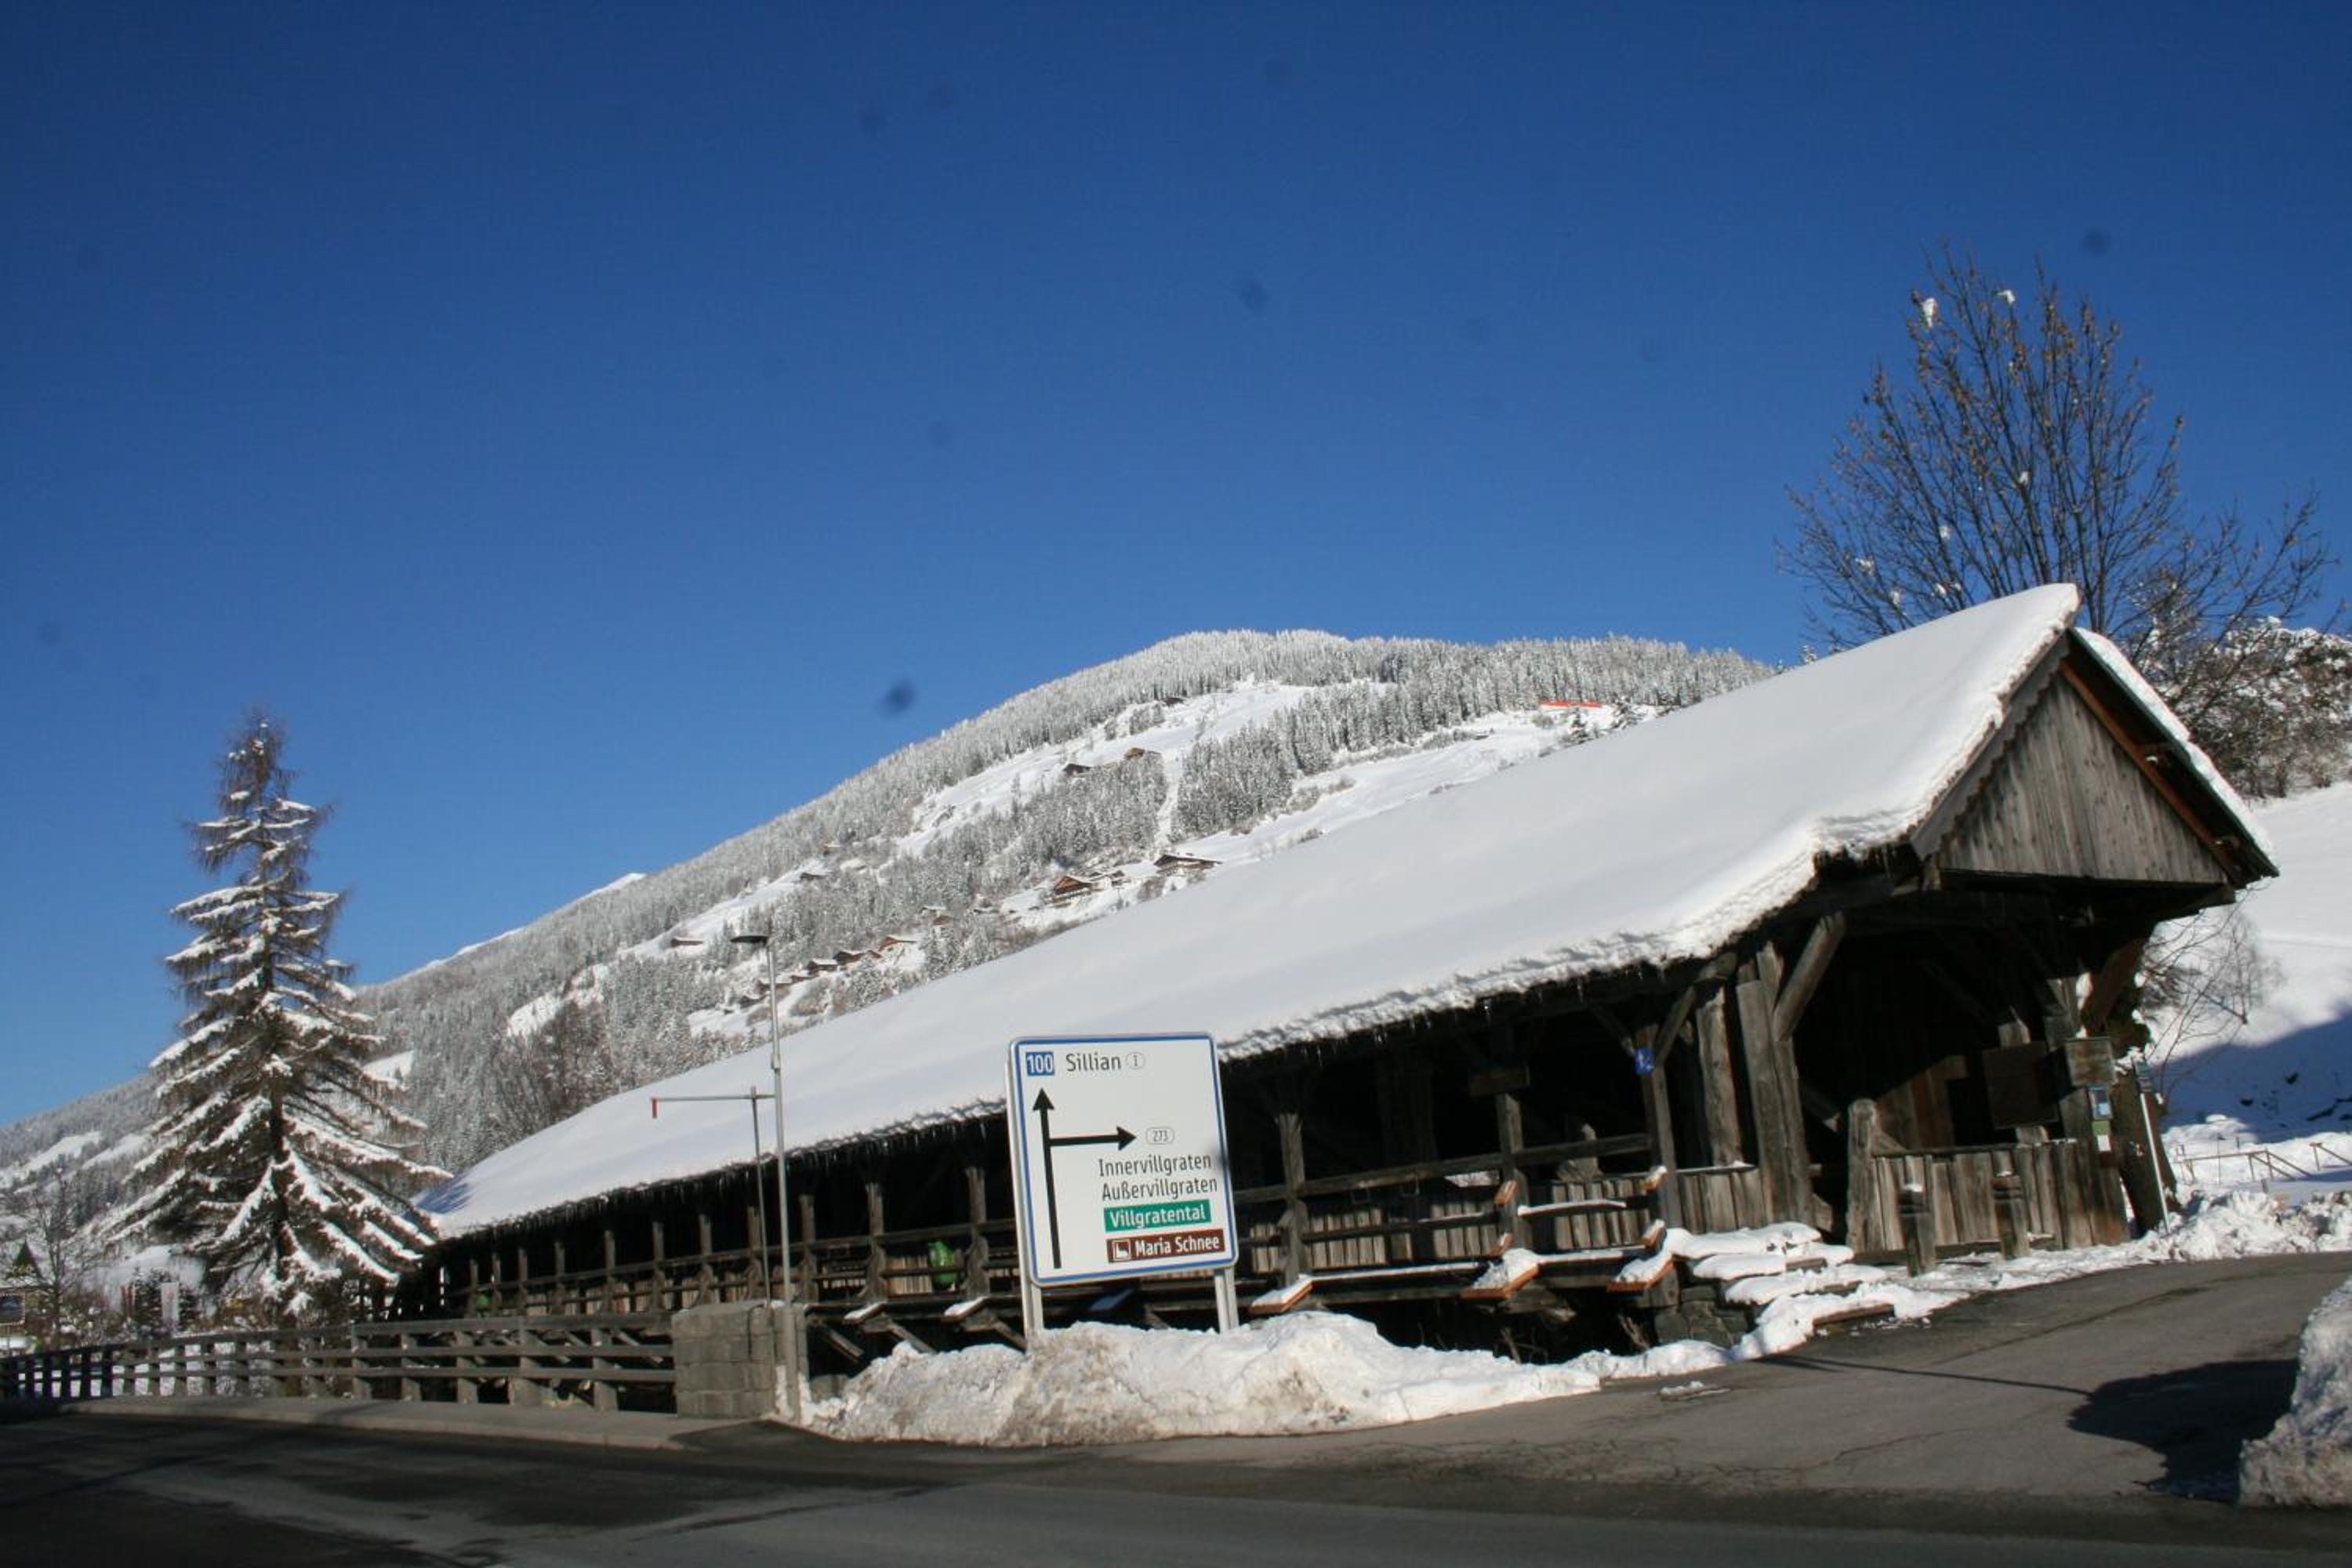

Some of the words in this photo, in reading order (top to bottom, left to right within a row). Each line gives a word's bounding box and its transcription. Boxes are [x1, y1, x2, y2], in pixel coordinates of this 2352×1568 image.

[1028, 1054, 1053, 1073] 100
[1065, 1052, 1121, 1072] Sillian
[1152, 1130, 1168, 1142] 273
[1098, 1154, 1211, 1177] Innervillgraten
[1102, 1178, 1218, 1201] Außervillgraten
[1110, 1204, 1206, 1229] Villgratental
[1135, 1237, 1171, 1257] Maria
[1176, 1236, 1220, 1252] Schnee
